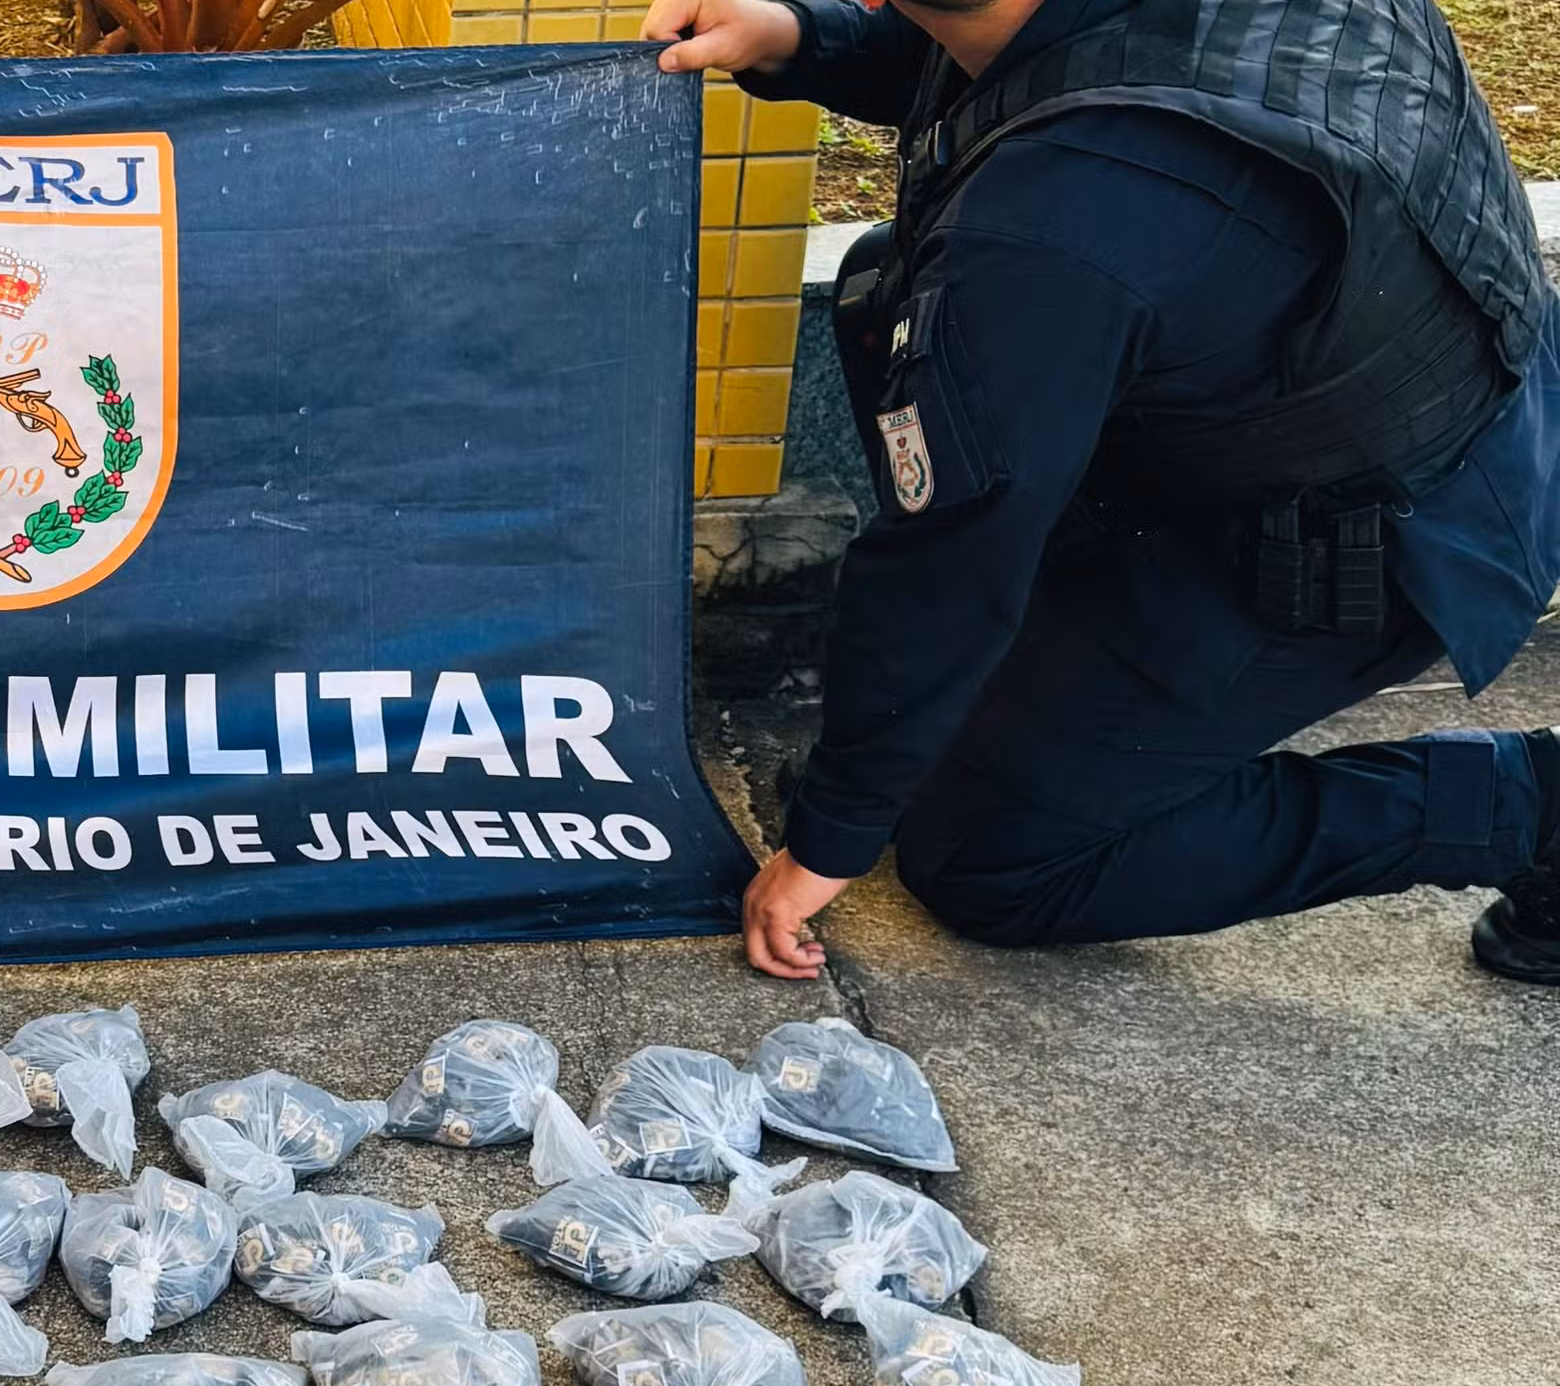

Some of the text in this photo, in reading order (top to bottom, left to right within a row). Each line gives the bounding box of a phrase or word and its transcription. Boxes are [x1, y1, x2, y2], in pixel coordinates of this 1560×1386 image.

[7, 670, 633, 783] MILITAR
[158, 815, 276, 867] DE
[295, 810, 672, 863] JANEIRO
